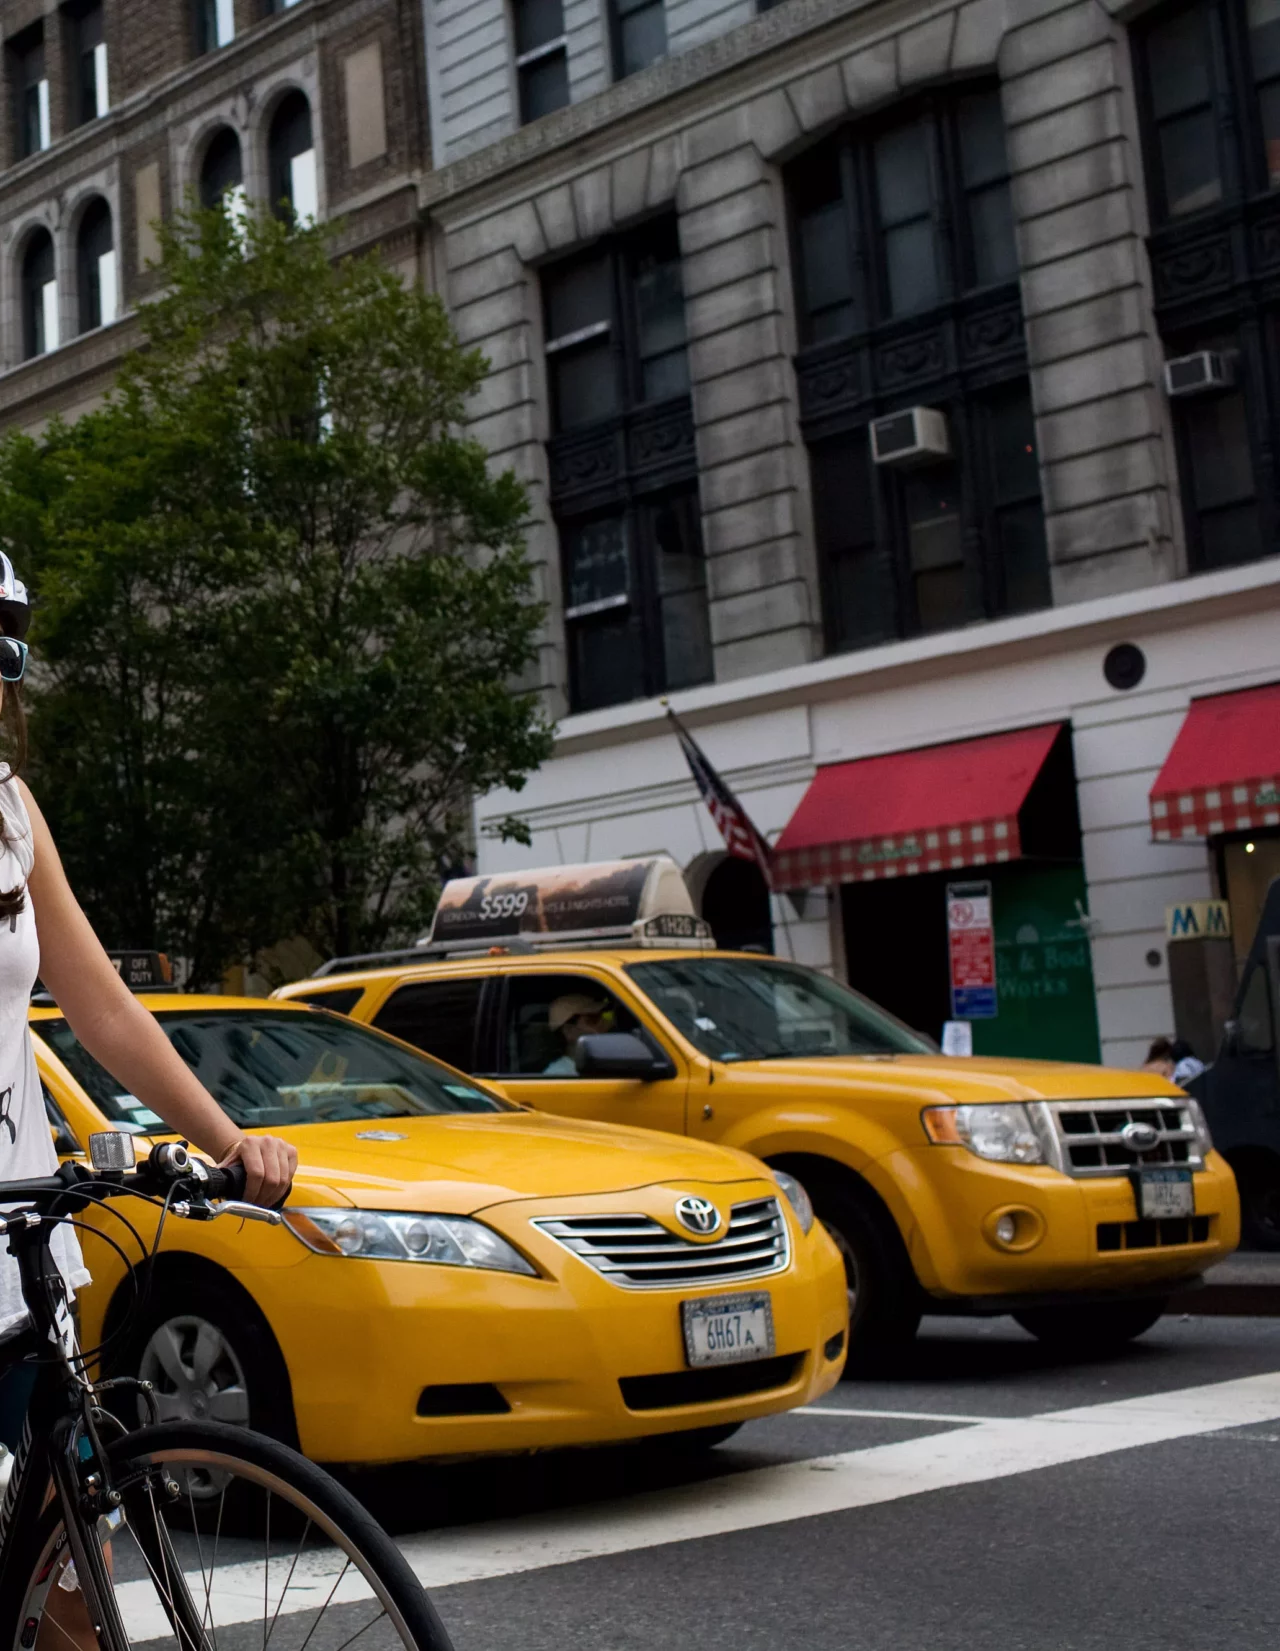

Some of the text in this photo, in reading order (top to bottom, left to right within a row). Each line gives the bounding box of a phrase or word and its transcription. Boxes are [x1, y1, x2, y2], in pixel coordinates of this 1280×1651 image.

[478, 892, 529, 922] $599
[131, 958, 148, 969] OFF
[130, 971, 153, 983] DUTY
